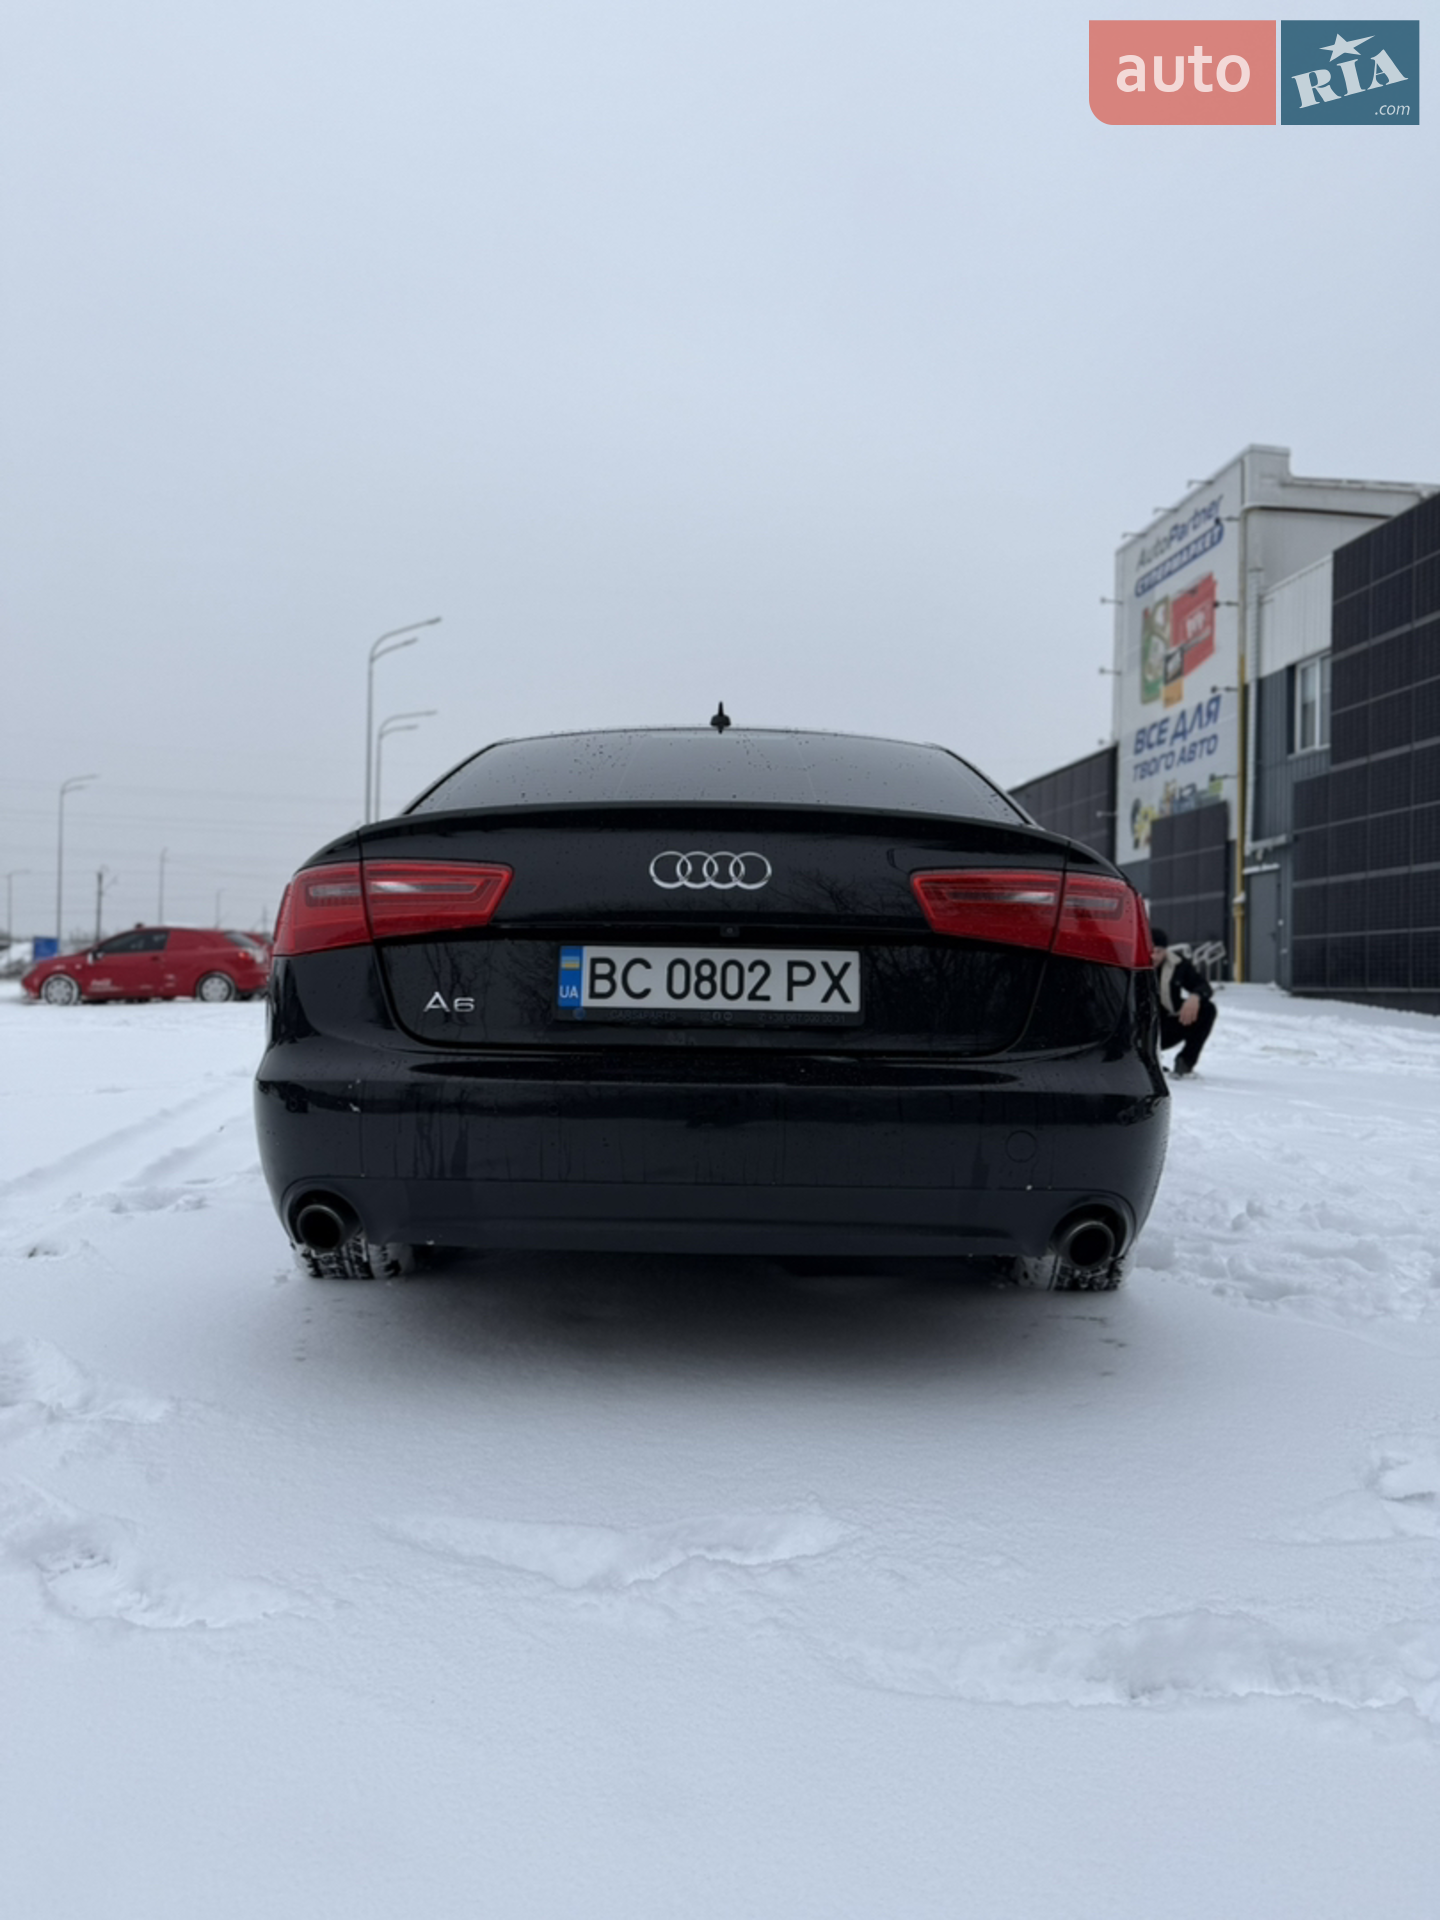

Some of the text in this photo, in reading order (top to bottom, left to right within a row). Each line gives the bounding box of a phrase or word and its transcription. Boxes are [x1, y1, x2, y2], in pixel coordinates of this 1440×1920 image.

[1136, 494, 1223, 572] AutoPartner
[1134, 694, 1221, 755] ВСЕ ДЛЯ
[1133, 733, 1218, 782] ТВОГО АВТО
[423, 991, 475, 1013] A6
[559, 985, 579, 999] UA
[588, 956, 852, 1005] BC 0802 PX
